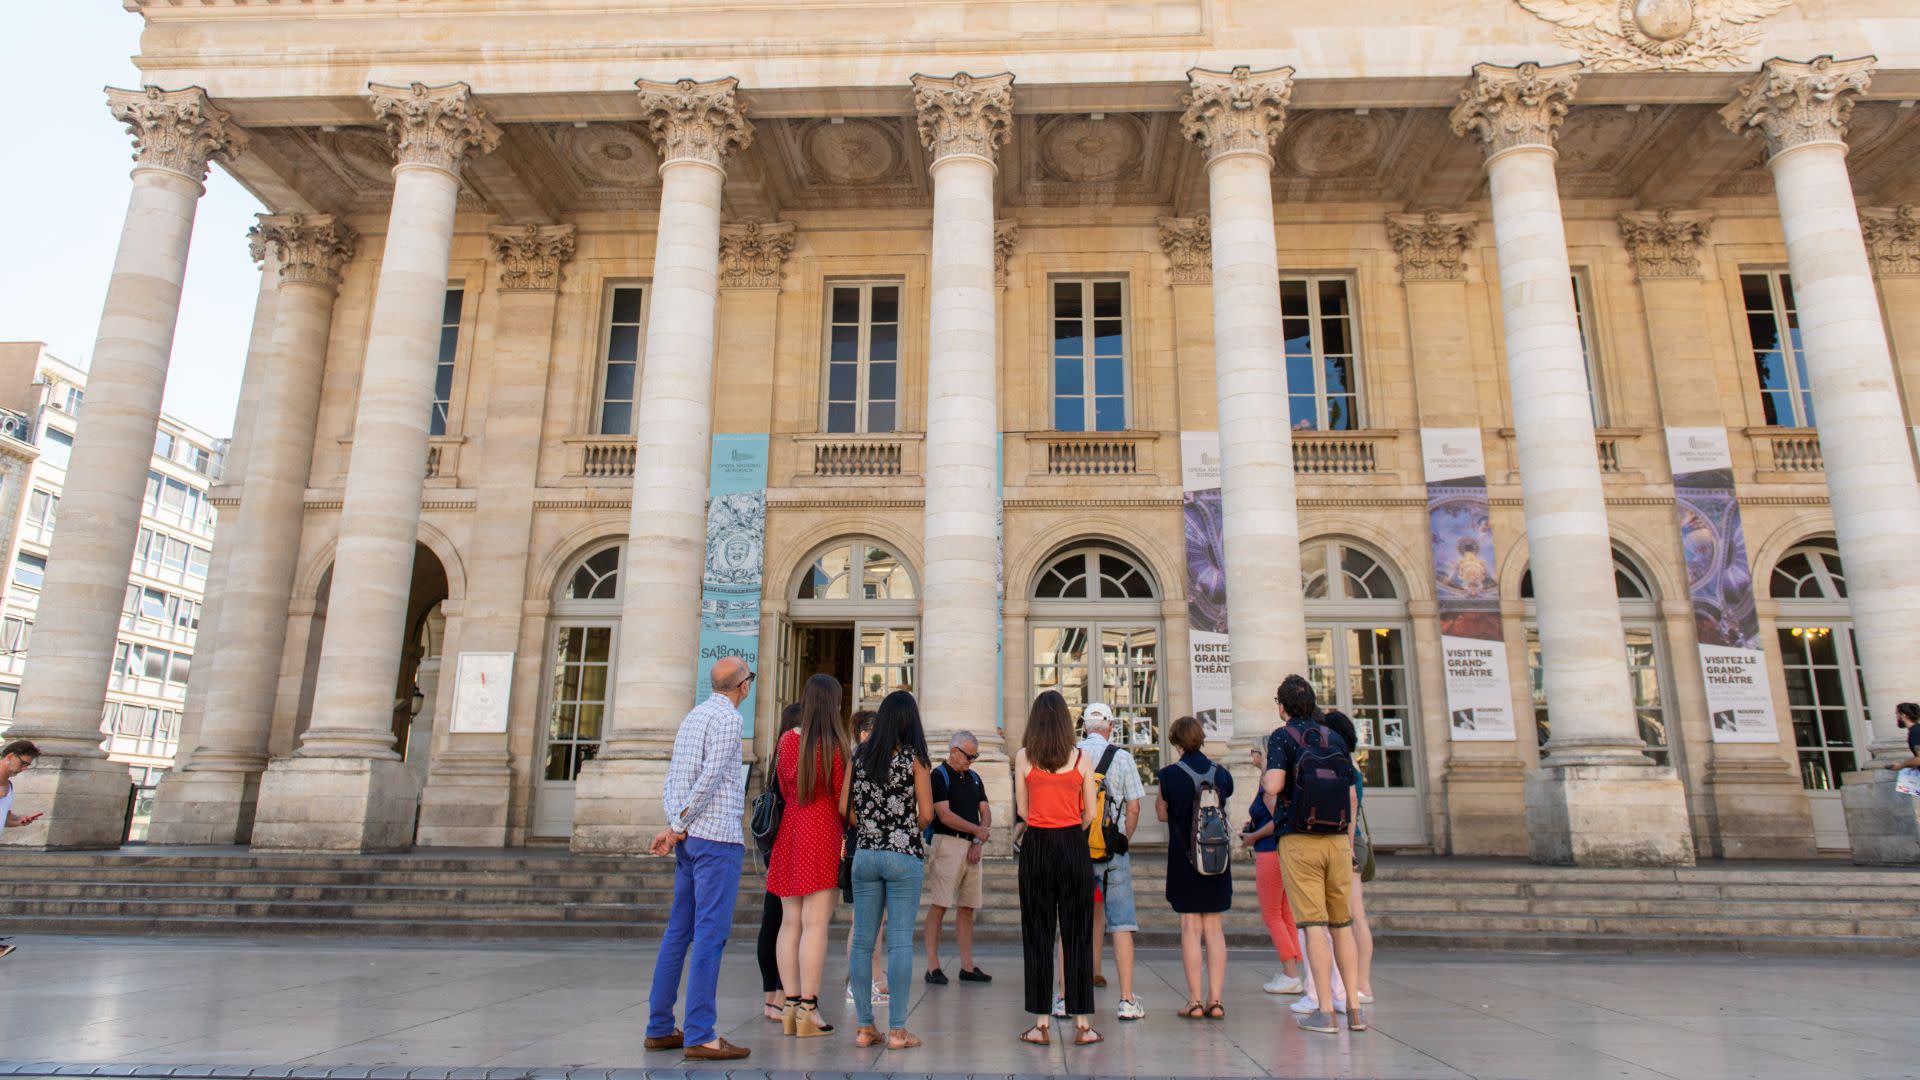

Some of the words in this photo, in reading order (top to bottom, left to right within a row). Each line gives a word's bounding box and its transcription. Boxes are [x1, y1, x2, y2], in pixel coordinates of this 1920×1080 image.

[1446, 649, 1472, 657] VISIT
[1473, 649, 1493, 657] THE
[1447, 659, 1486, 667] GRAND-
[1704, 656, 1743, 664] VISITEZ
[1744, 656, 1757, 664] LE
[1194, 662, 1231, 674] THÉÂT
[1448, 667, 1493, 677] THÉÂTRE
[1706, 666, 1746, 674] GRAND-
[1707, 674, 1753, 684] THÉÂTRE
